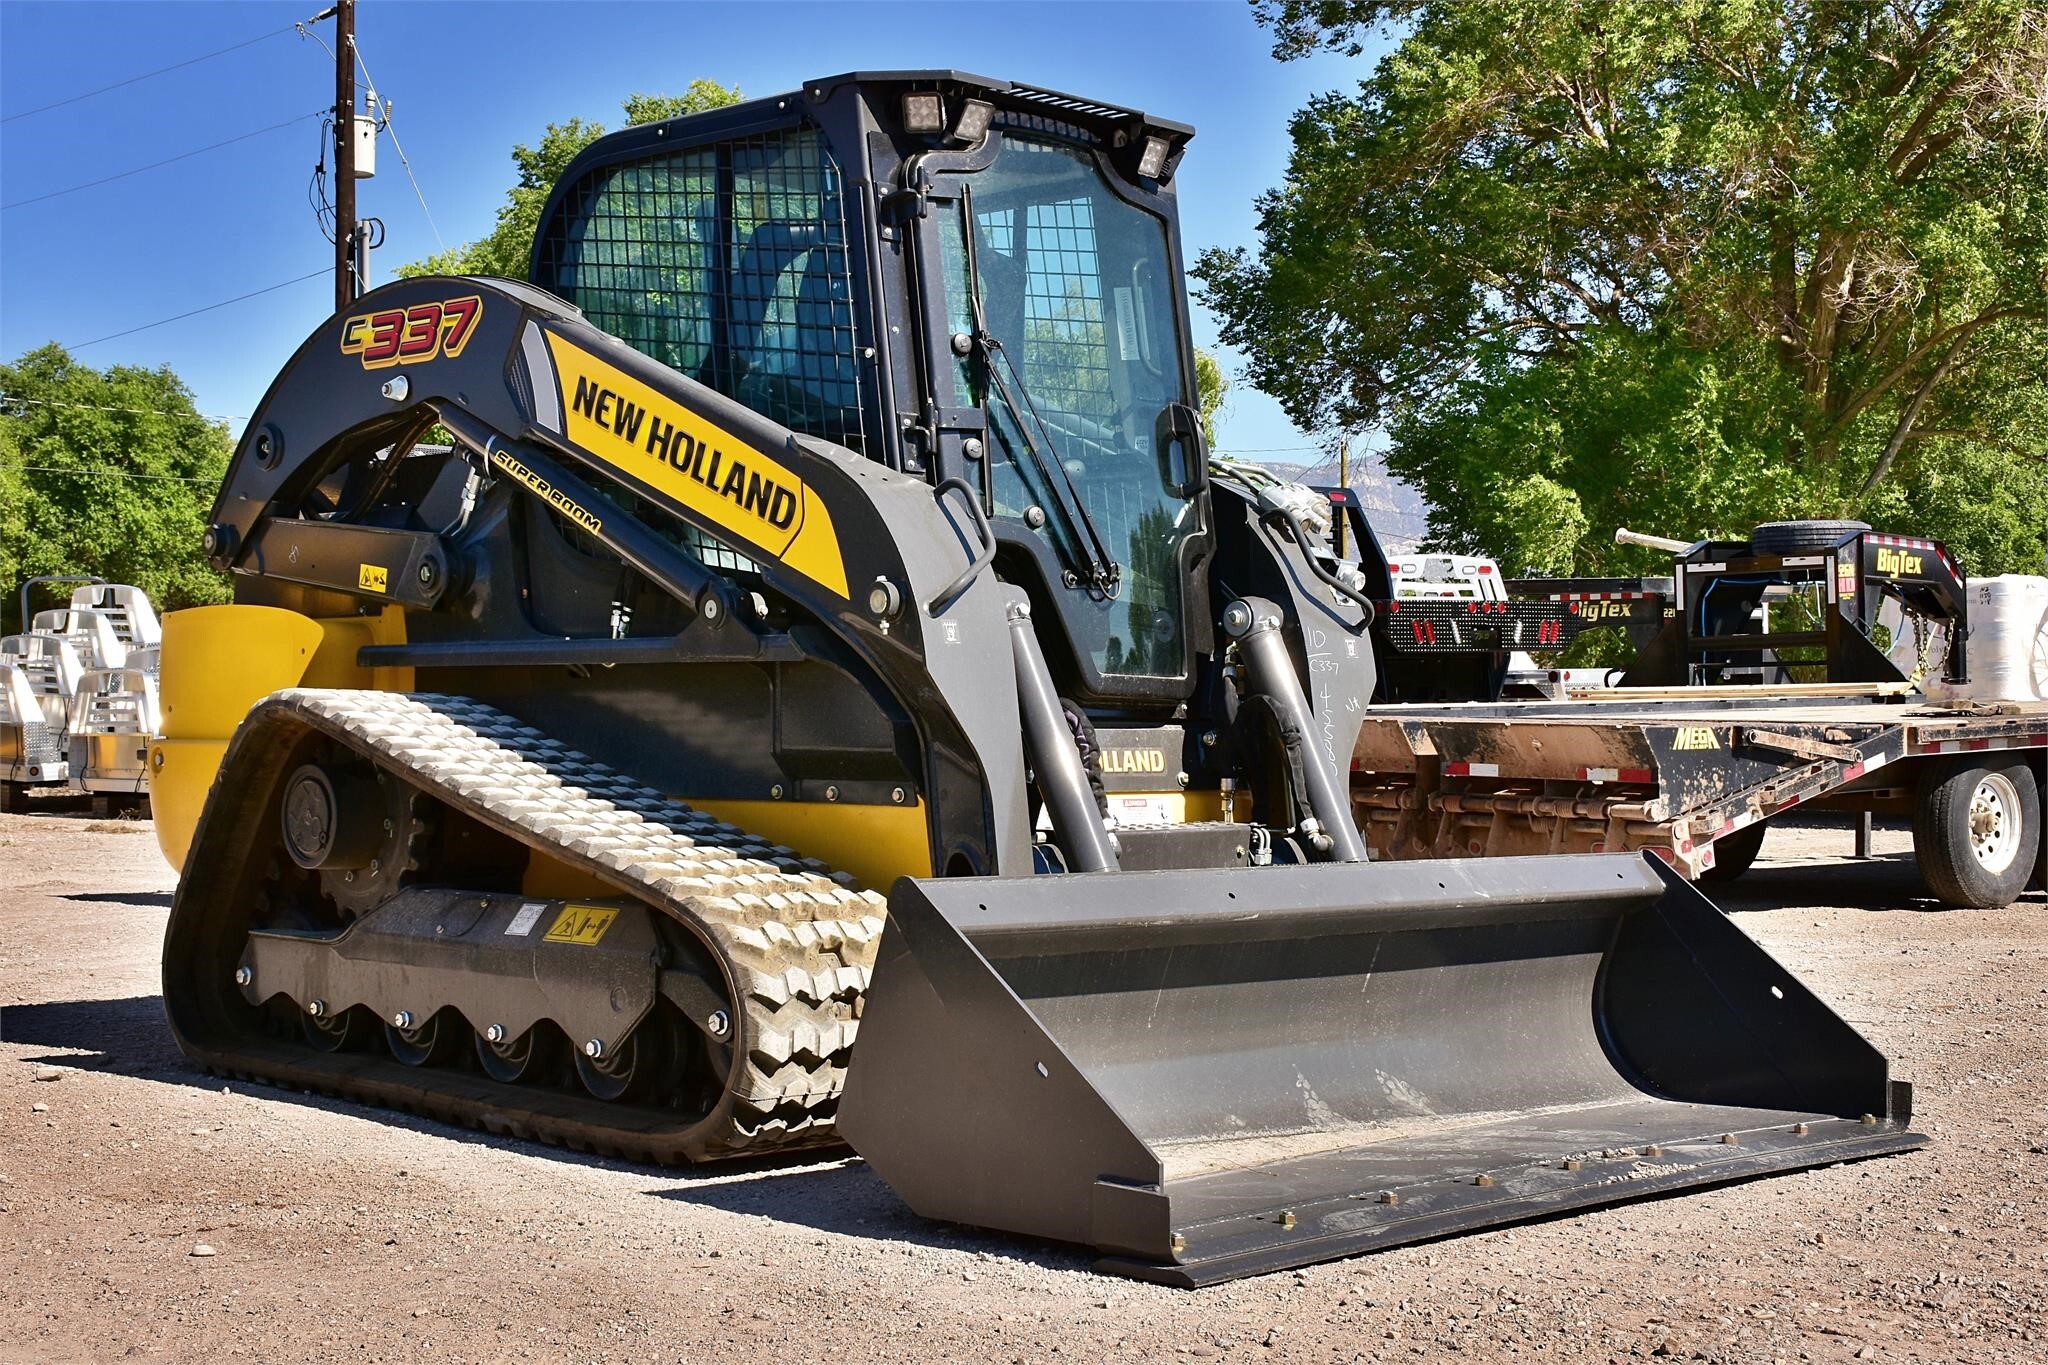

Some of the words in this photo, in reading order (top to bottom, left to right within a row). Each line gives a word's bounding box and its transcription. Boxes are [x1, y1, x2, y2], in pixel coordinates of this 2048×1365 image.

[341, 295, 482, 368] C337
[572, 375, 646, 444] NEW
[645, 415, 797, 531] HOLLAND
[496, 450, 550, 499] SUPER
[549, 489, 601, 535] BOOM
[1877, 548, 1922, 578] BigTex
[1309, 659, 1339, 675] C337
[1672, 727, 1721, 750] MEGA
[1099, 750, 1164, 773] LLAND
